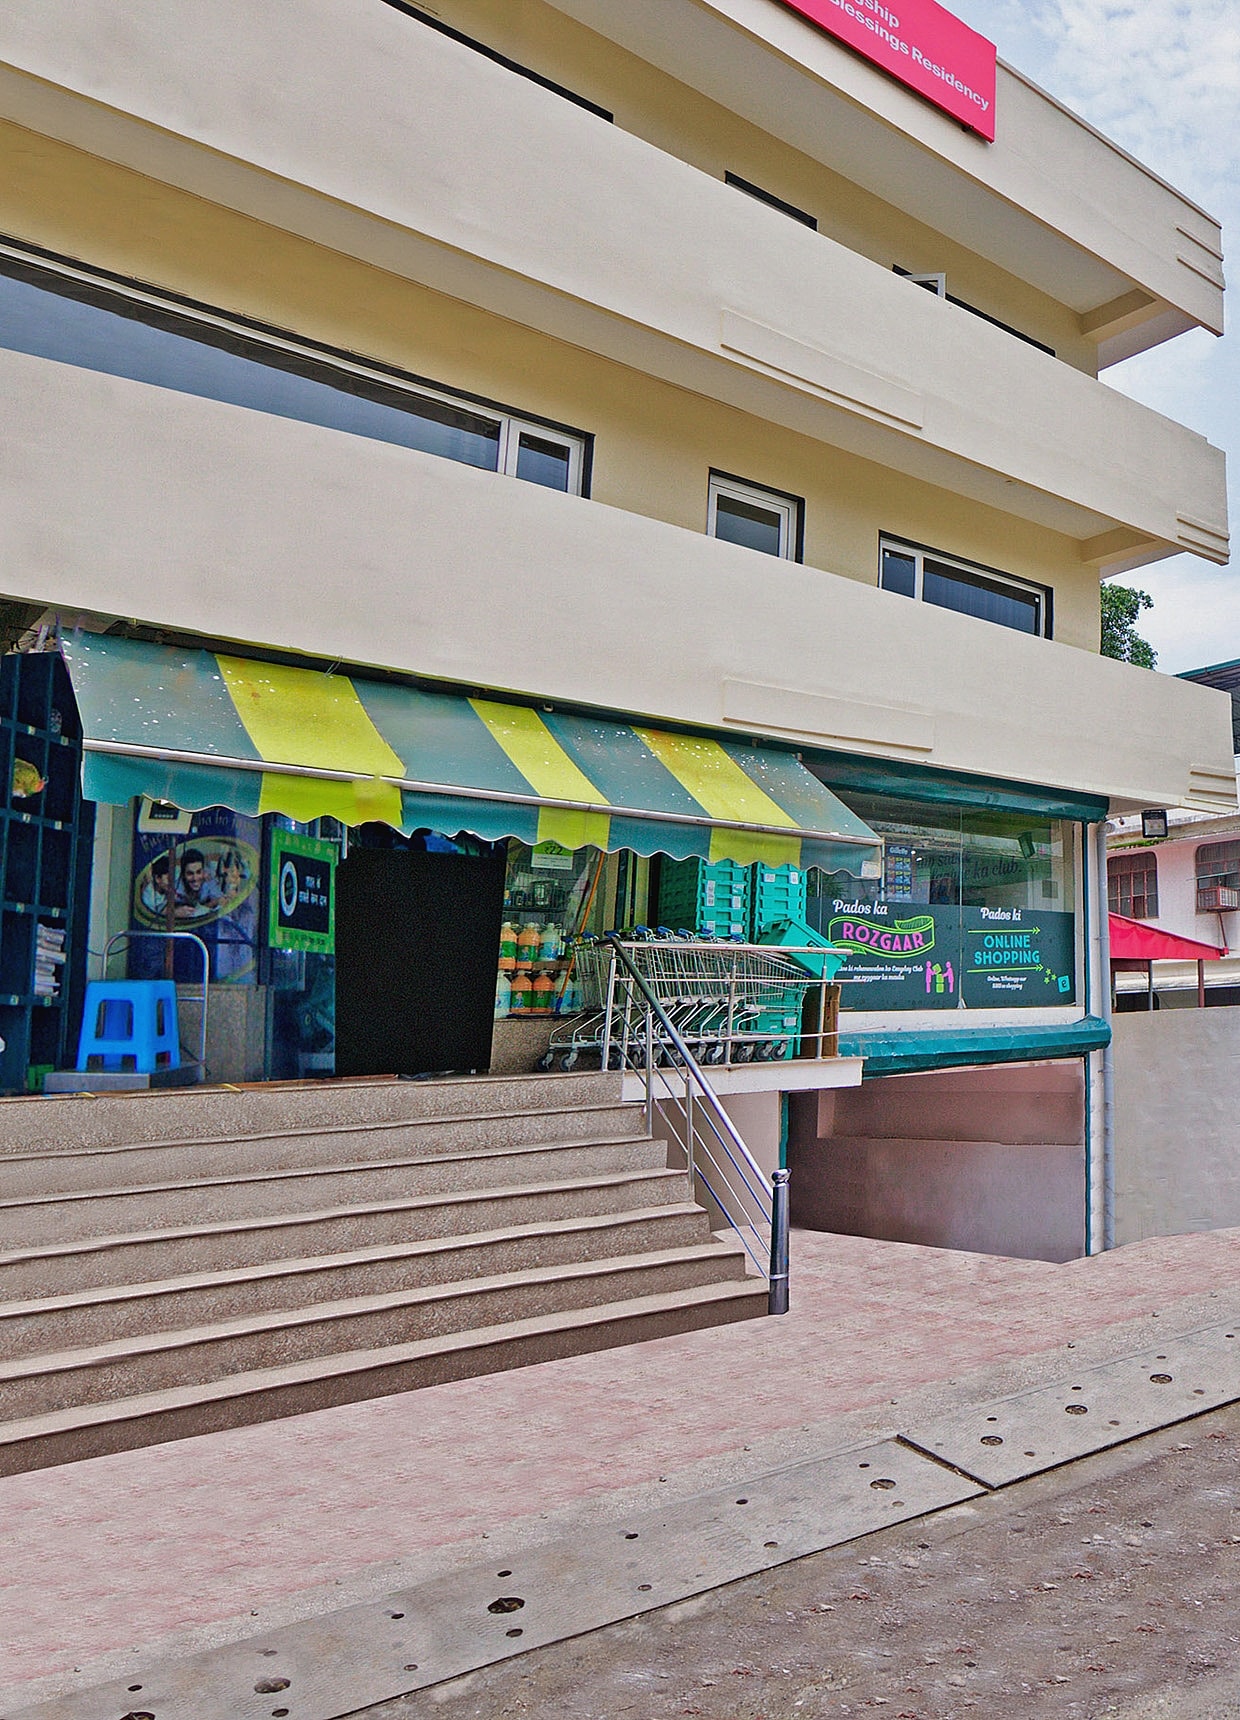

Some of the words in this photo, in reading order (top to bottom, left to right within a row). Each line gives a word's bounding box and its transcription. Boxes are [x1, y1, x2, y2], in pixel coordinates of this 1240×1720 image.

[911, 47, 990, 111] Residency
[832, 899, 871, 914] Pados
[873, 900, 888, 915] ka
[980, 907, 1011, 920] Pados
[1012, 908, 1022, 921] ki
[842, 922, 925, 951] ROZGAAR
[984, 935, 1031, 948] ONLINE
[974, 950, 1040, 965] SHOPPING
